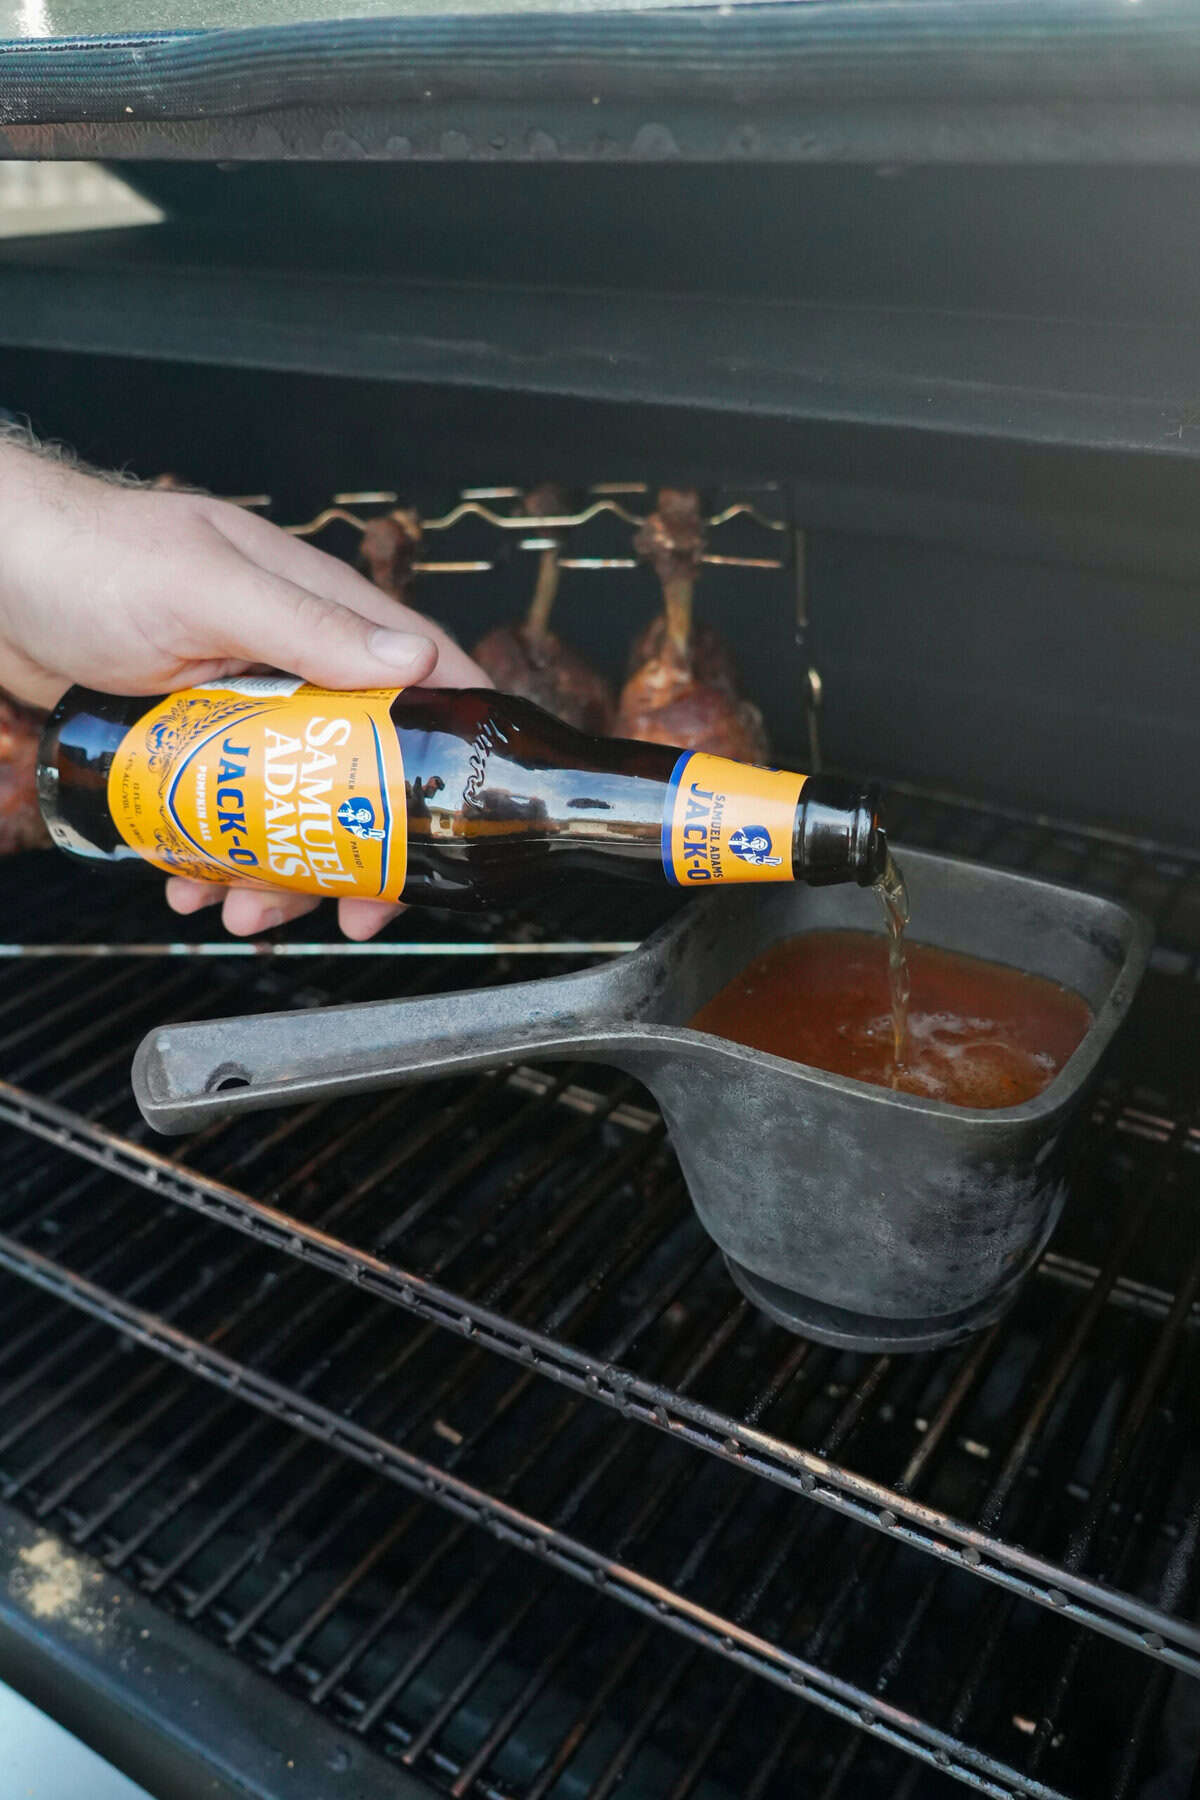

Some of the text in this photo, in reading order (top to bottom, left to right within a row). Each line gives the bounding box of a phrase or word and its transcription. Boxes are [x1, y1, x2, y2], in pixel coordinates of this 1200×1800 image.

[197, 765, 212, 840] PUMPKIN ALE
[217, 739, 259, 866] JACK-O
[264, 727, 311, 878] ADAMS
[300, 717, 356, 888] SAMUEL
[684, 783, 714, 880] JACK-O
[710, 795, 726, 879] SAMUEL ADAMS
[349, 841, 365, 869] PATRIOT
